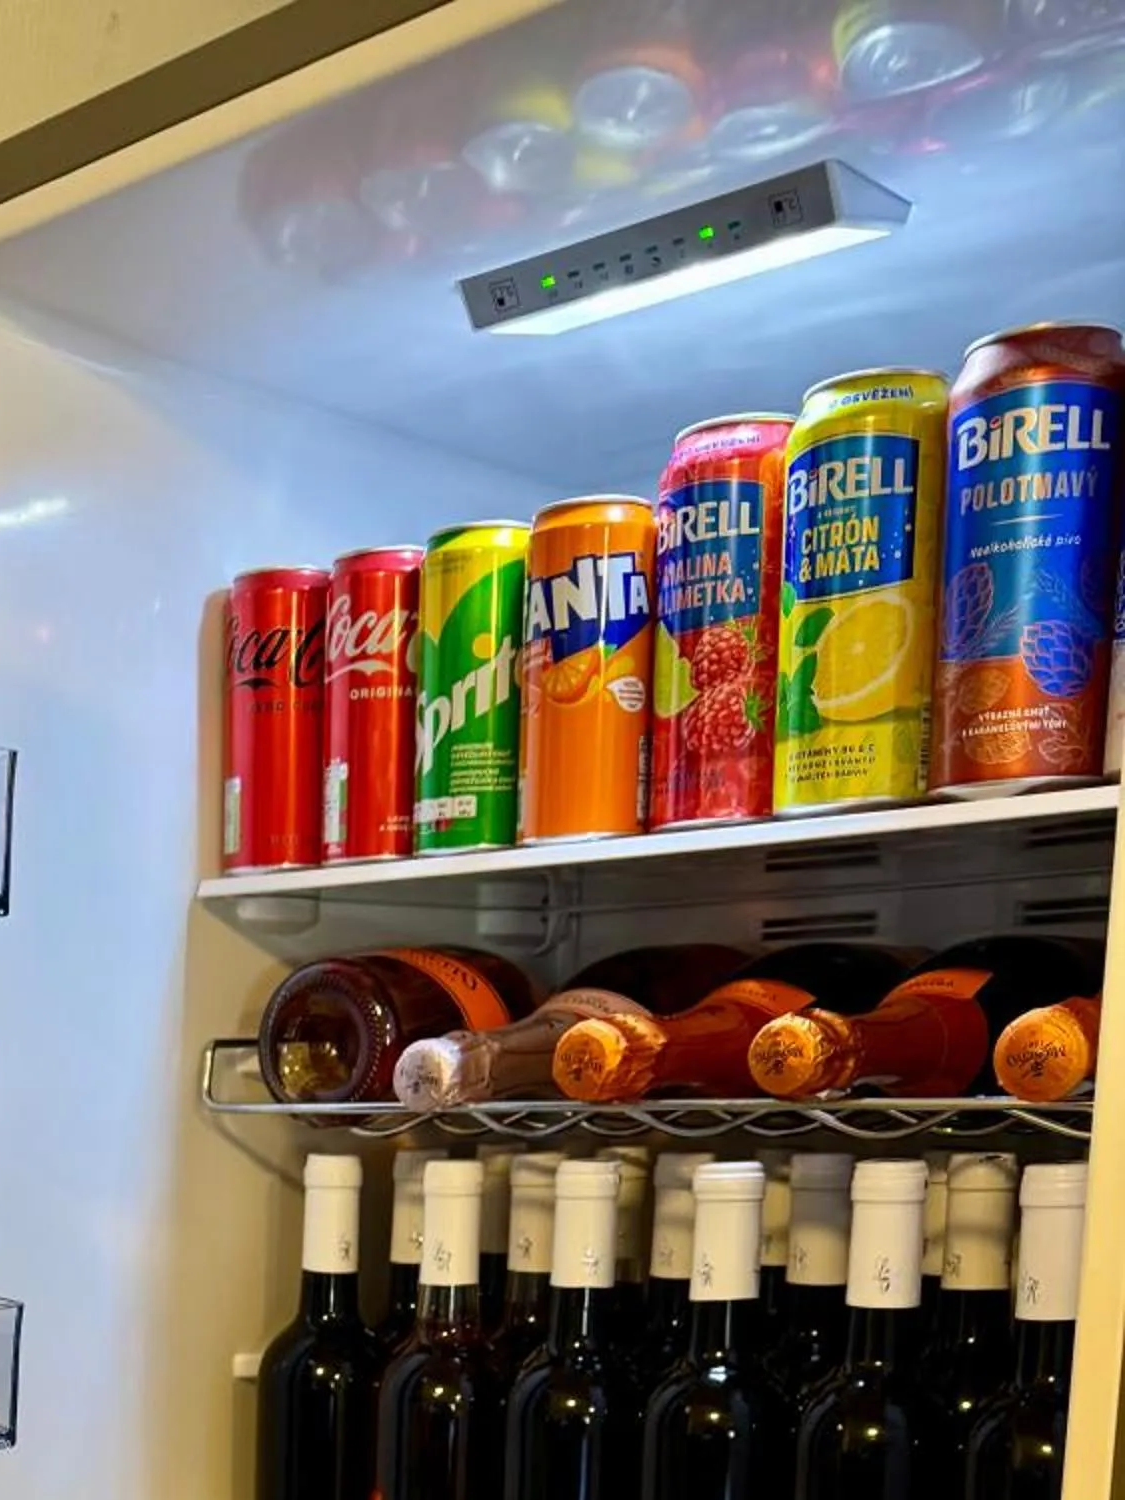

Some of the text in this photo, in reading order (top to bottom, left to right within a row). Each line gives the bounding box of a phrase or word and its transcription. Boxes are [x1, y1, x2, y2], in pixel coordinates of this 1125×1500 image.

[960, 466, 1098, 516] POLOTMAVÝ
[802, 515, 880, 555] CITRÓN
[799, 543, 880, 583] & MÁTA
[526, 554, 649, 639] ANTA
[349, 686, 413, 700] ORIGINA
[415, 634, 517, 776] prit
